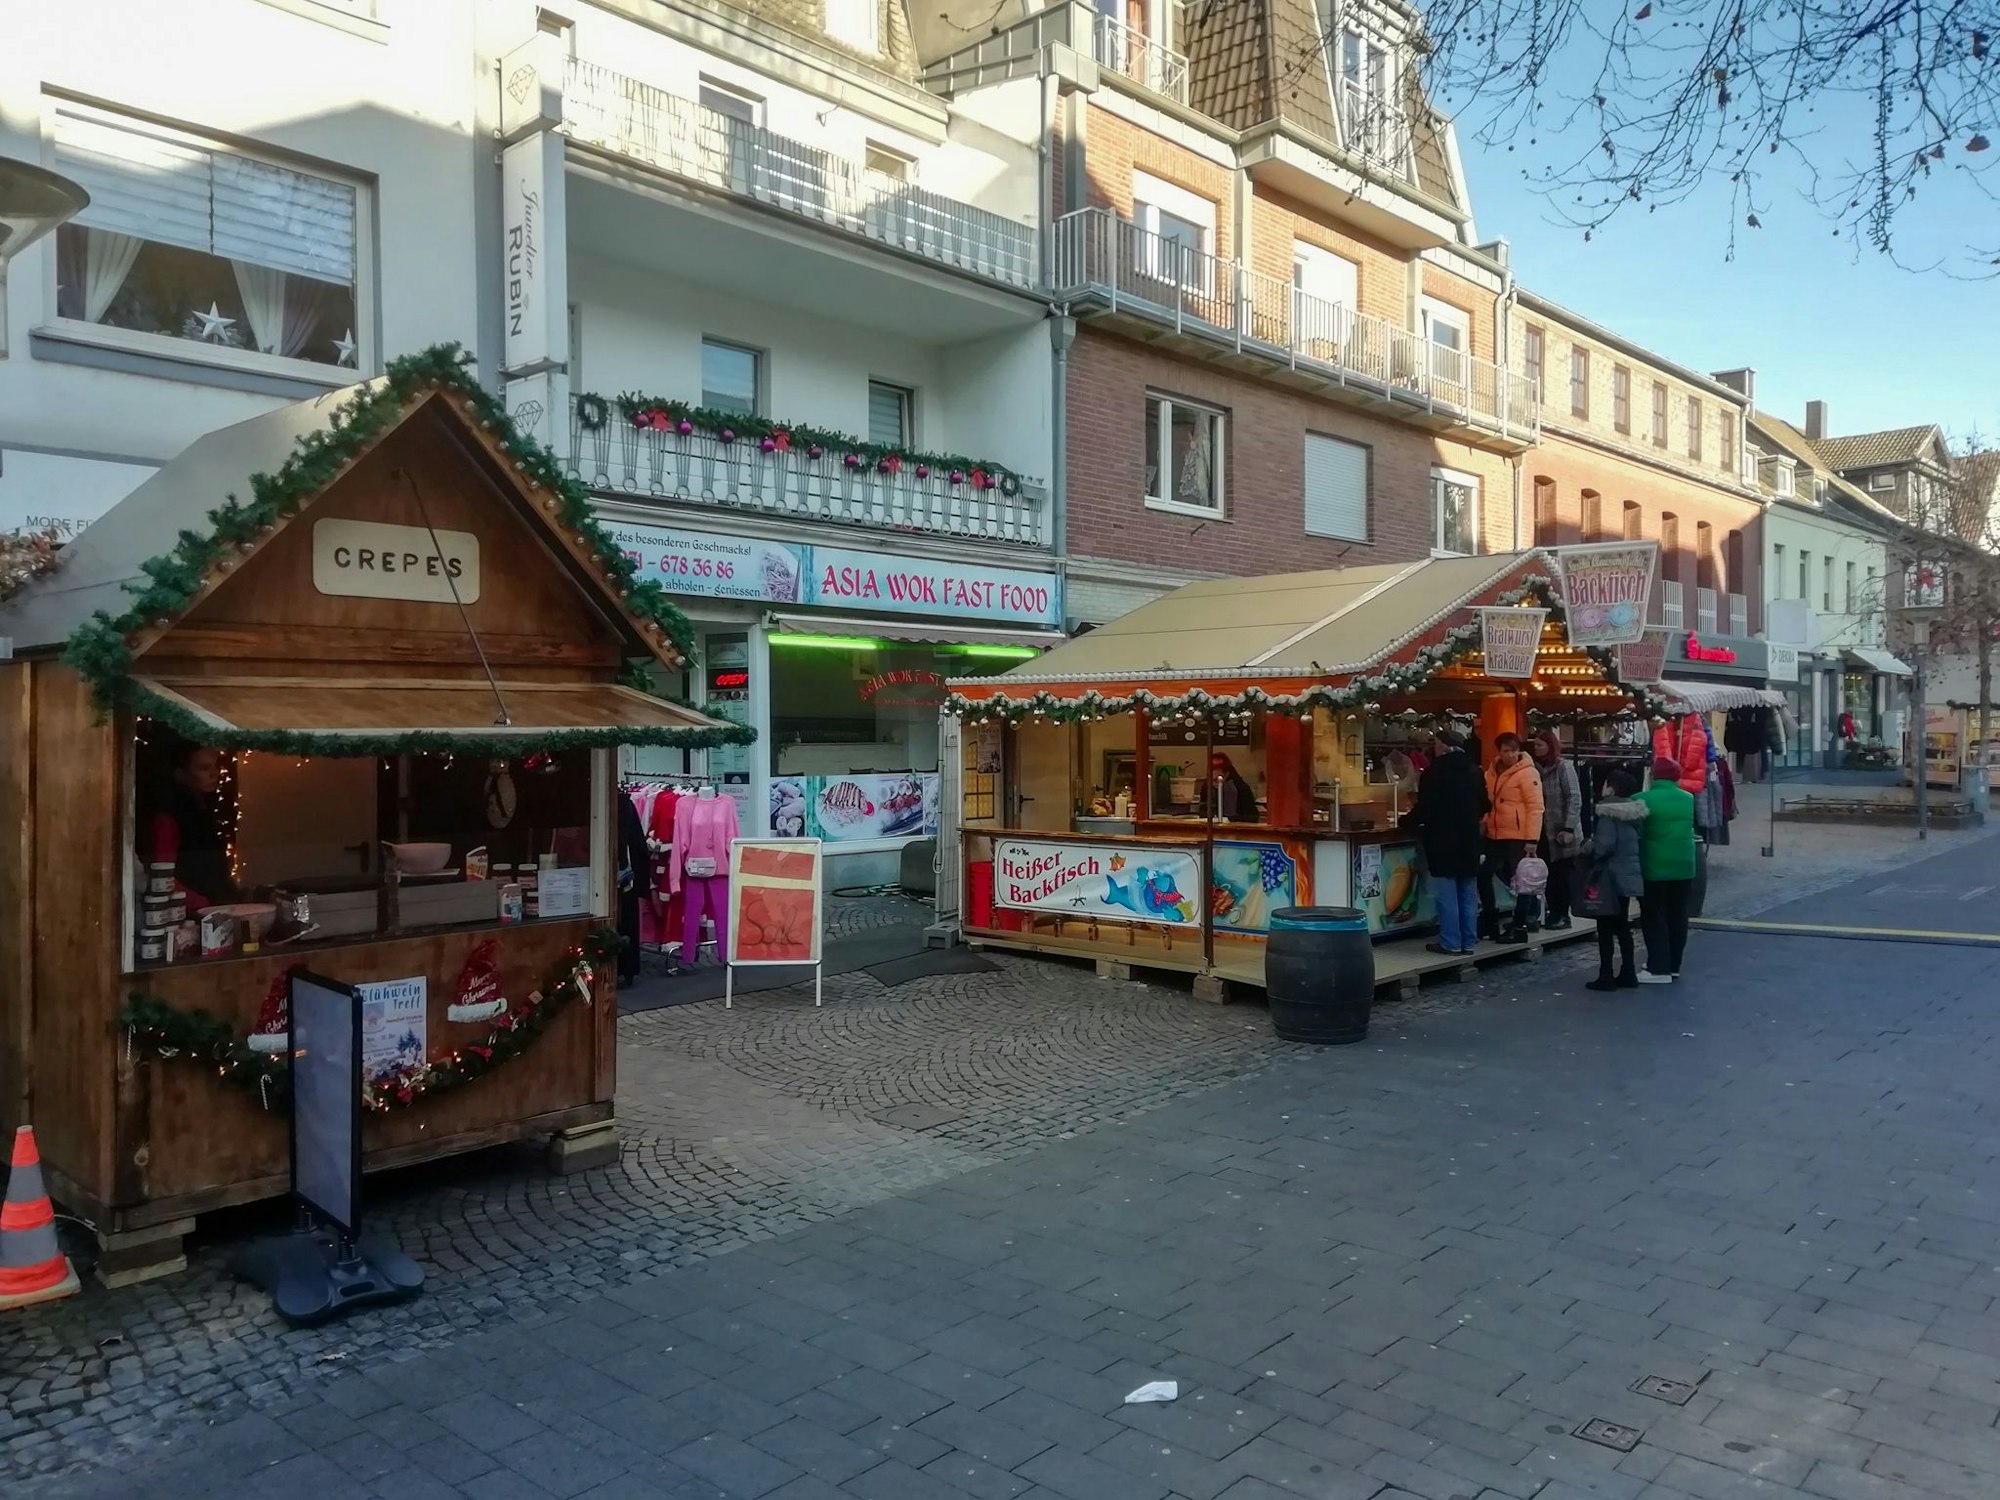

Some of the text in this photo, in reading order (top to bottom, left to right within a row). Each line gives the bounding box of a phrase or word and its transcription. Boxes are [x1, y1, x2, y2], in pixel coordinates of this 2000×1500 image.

[520, 178, 540, 281] Juwelier
[509, 225, 523, 337] RUBIN
[26, 515, 71, 530] MODE
[615, 531, 752, 556] des besonderen Geschmacks!
[334, 547, 462, 578] CREPES
[660, 554, 688, 575] 678
[692, 558, 713, 577] 36
[716, 561, 734, 580] 86
[665, 579, 705, 593] abholen
[714, 583, 761, 597] geniessen
[821, 564, 1048, 614] ASIA WOK FAST FOOD
[1566, 569, 1648, 606] Backfisch
[1488, 625, 1534, 647] Bratwurst
[1488, 650, 1531, 670] Krakauer
[715, 673, 748, 687] OPEN
[1003, 851, 1063, 881] Heißer
[1009, 857, 1099, 904] Backfisch
[393, 996, 421, 1010] Treff
